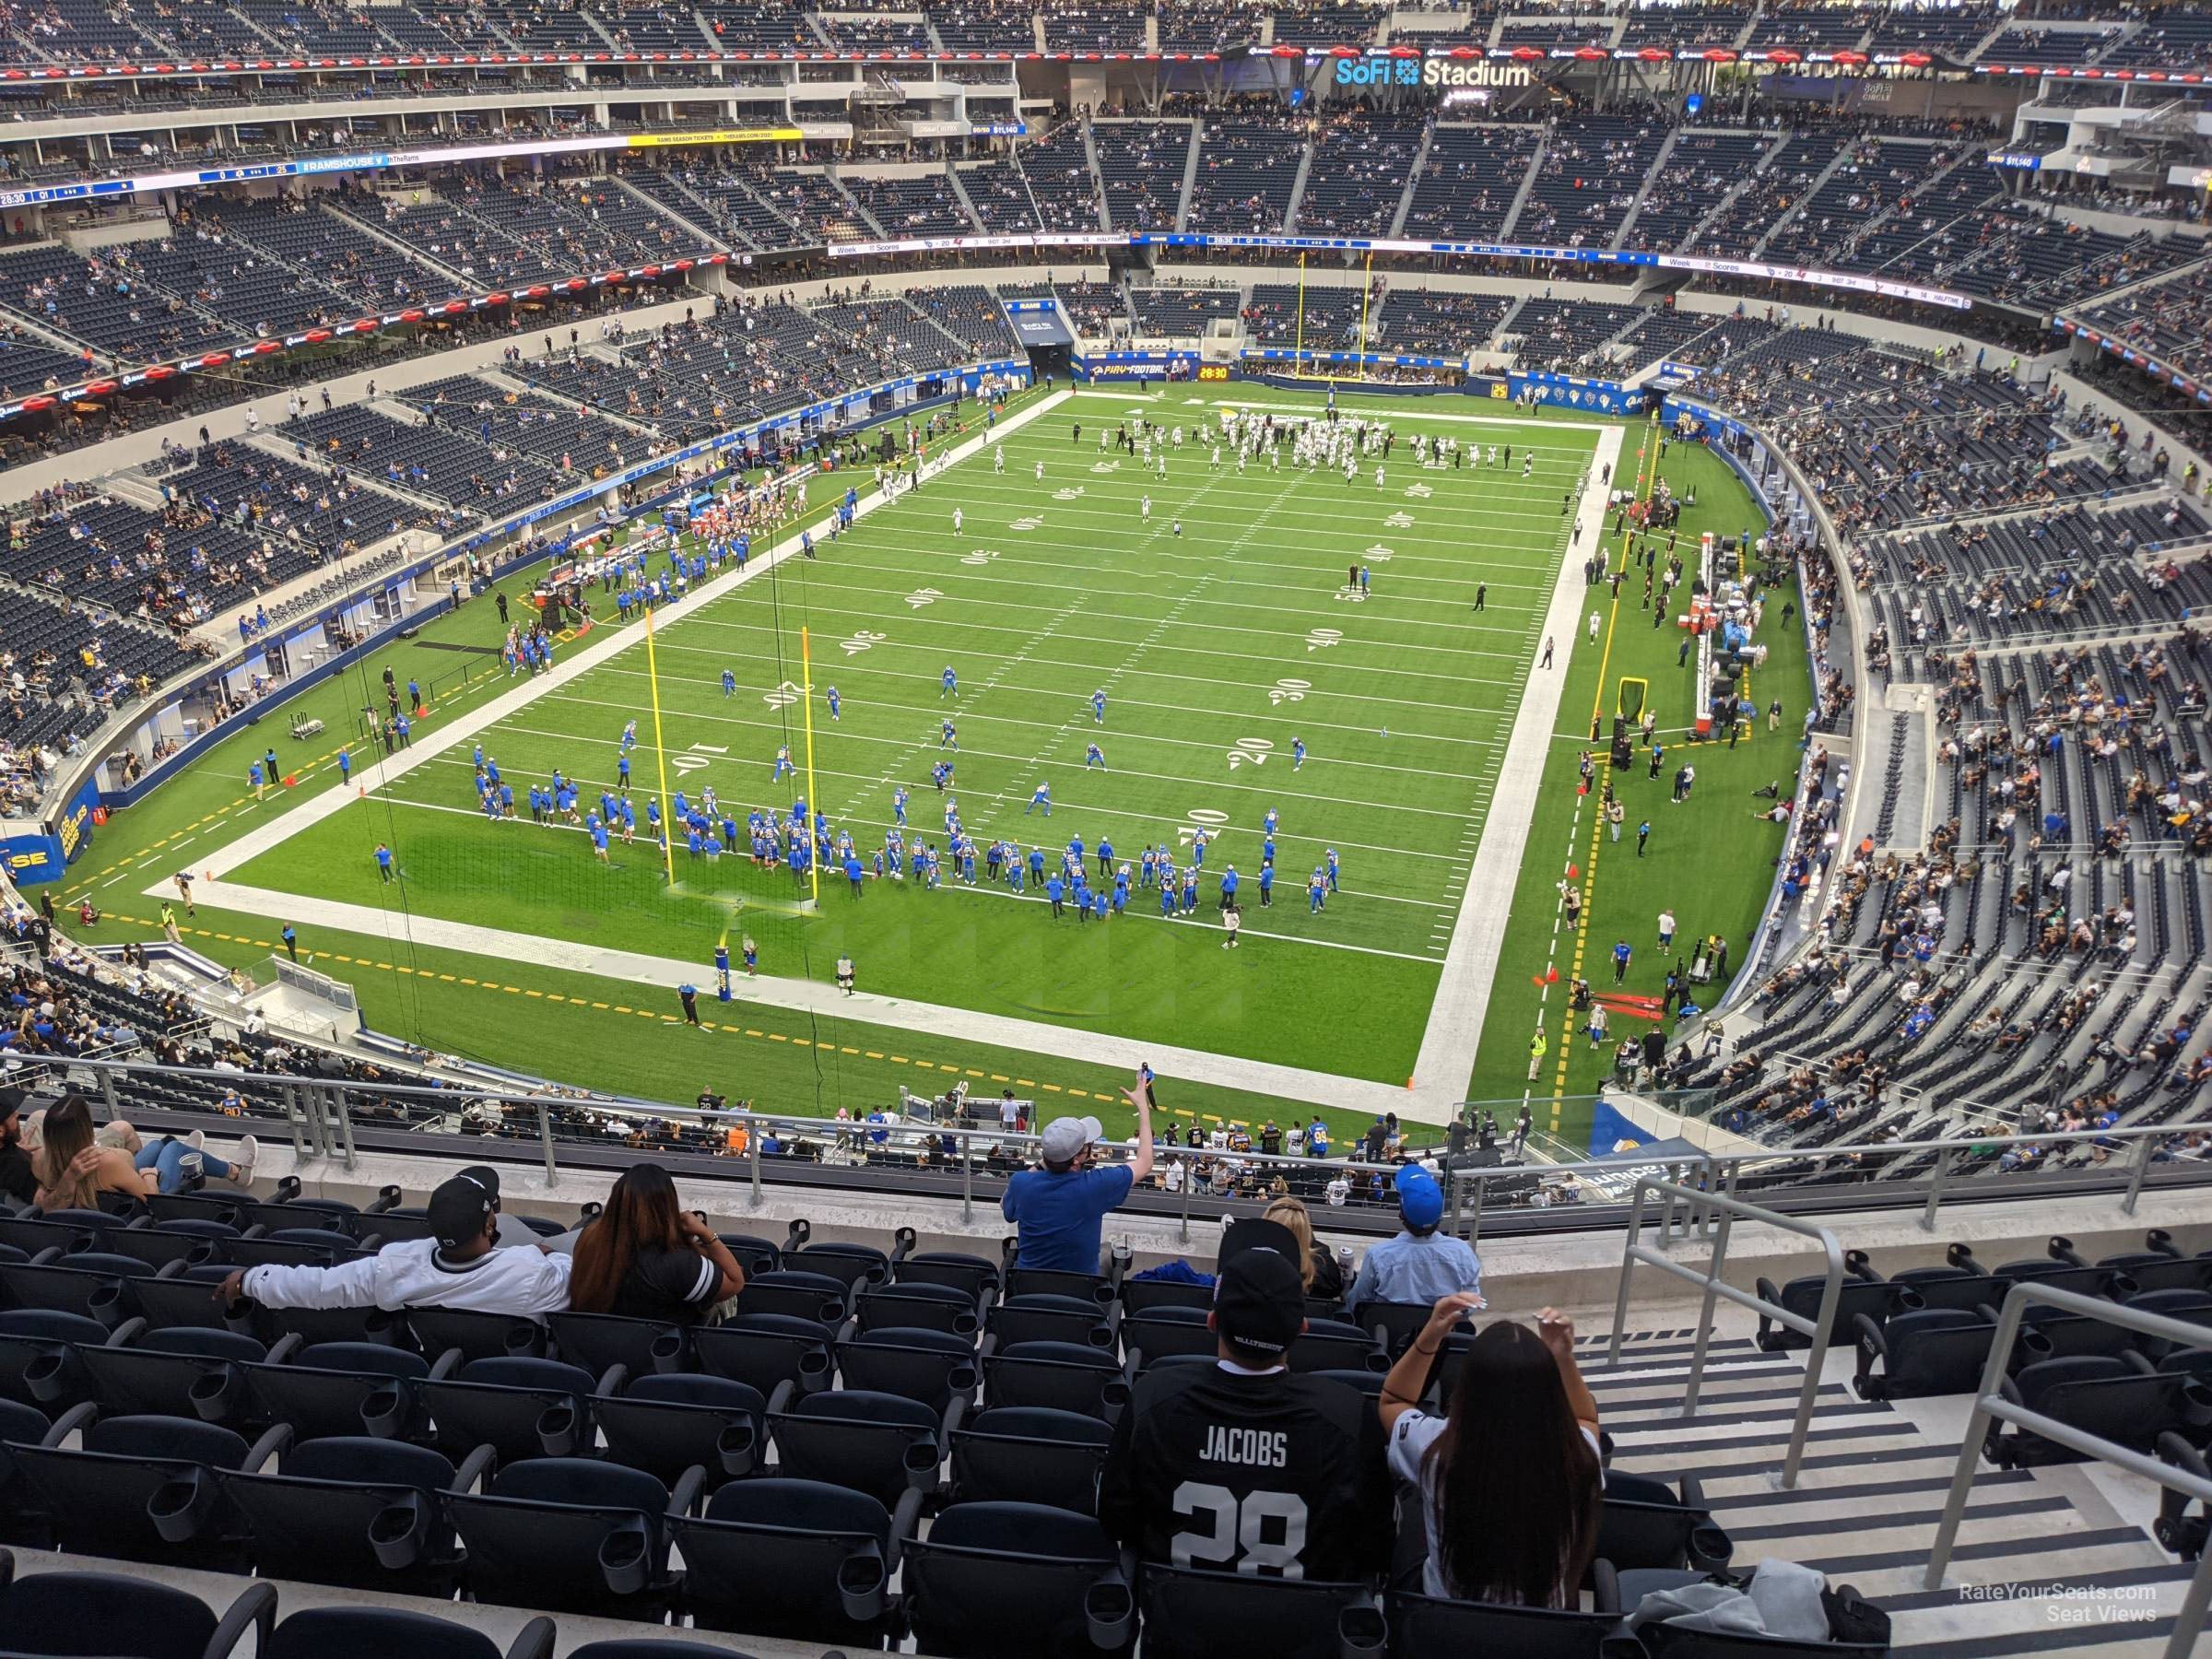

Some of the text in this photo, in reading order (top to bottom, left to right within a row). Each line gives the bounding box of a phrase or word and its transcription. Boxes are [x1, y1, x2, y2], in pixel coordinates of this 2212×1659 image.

[1336, 58, 1530, 87] SoFi Stadium
[993, 124, 1018, 135] $11,140
[303, 155, 375, 172] #RAMSHOUSE
[1, 192, 26, 206] 28:30
[837, 246, 857, 254] Week
[877, 243, 900, 252] Scores
[1669, 258, 1690, 268] Week
[1712, 262, 1740, 272] Scores
[1200, 367, 1227, 379] 28:30
[366, 583, 385, 596] RAMS
[904, 587, 946, 606] 40
[299, 618, 319, 632] RAMS
[839, 629, 888, 652] 30
[1304, 628, 1344, 648] 40
[224, 654, 247, 672] RAMS
[762, 680, 816, 705] 20
[1268, 677, 1312, 701] 30
[671, 741, 730, 769] 10
[1226, 737, 1275, 765] 20
[59, 815, 70, 839] LOS
[63, 804, 88, 849] ANGELES
[1177, 808, 1230, 841] 10
[1314, 1131, 1327, 1144] 99
[1199, 1425, 1288, 1467] JACOBS
[1171, 1480, 1308, 1581] 28
